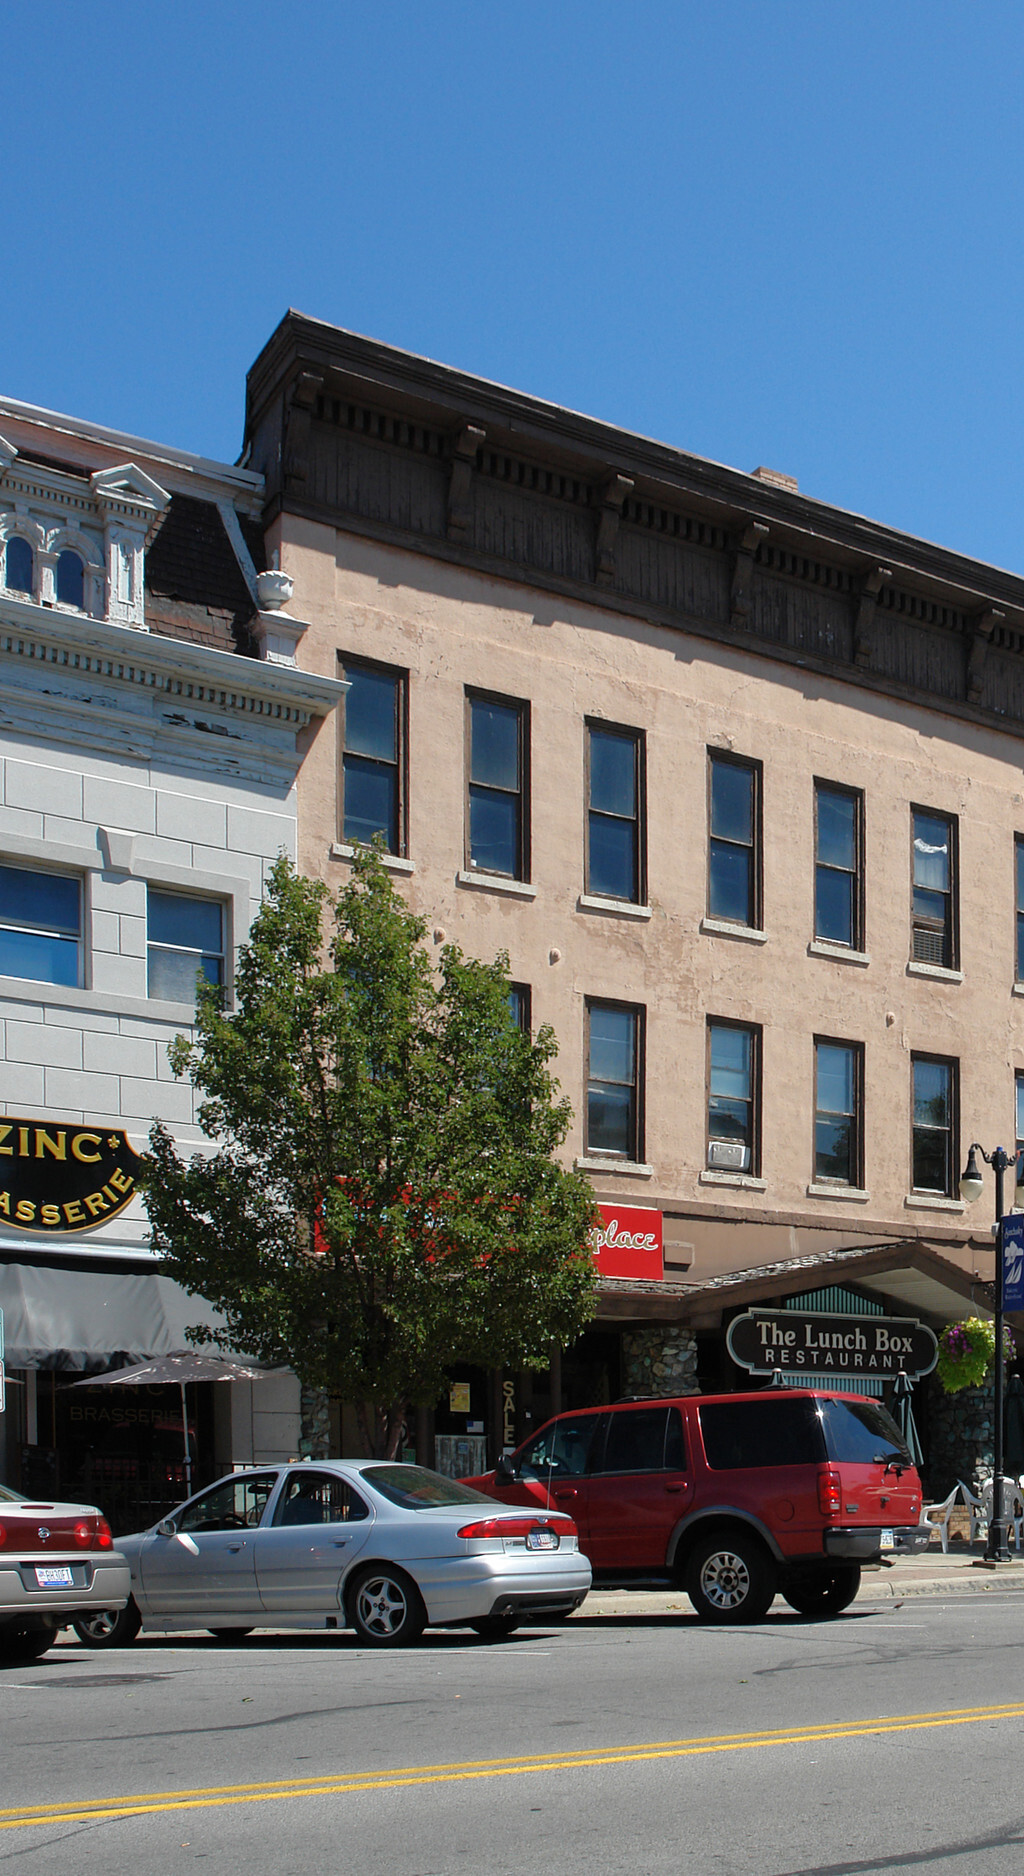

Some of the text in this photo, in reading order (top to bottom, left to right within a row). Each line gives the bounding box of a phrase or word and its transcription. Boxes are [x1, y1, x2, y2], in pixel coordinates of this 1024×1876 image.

[756, 1321, 913, 1353] The Lunch Box
[765, 1349, 906, 1369] RESTAURANT
[70, 1406, 181, 1423] BRASSERIE
[502, 1381, 516, 1444] SALE
